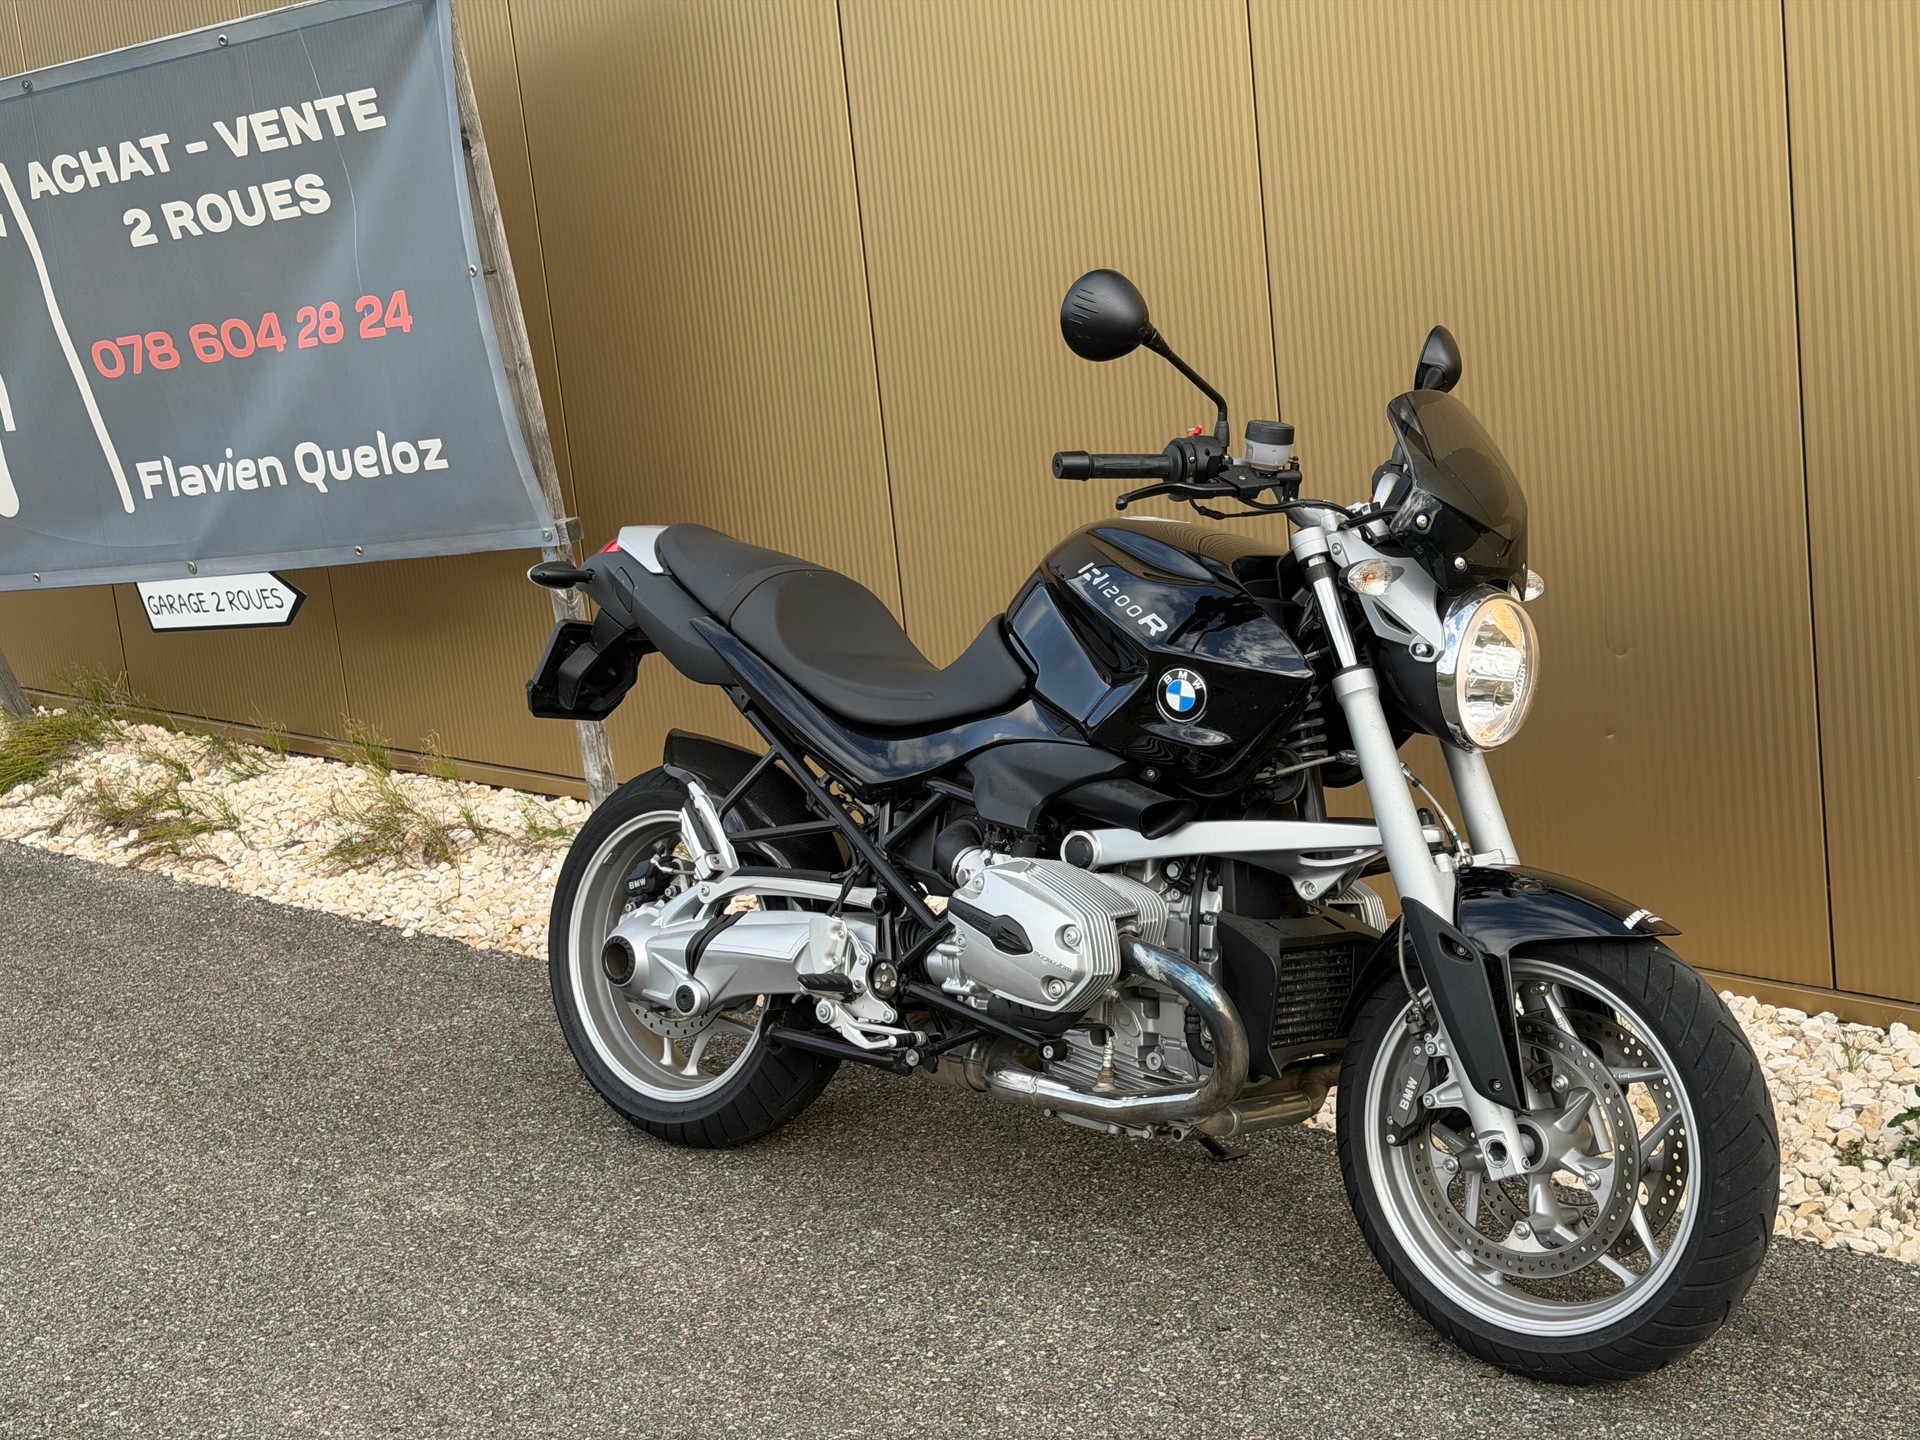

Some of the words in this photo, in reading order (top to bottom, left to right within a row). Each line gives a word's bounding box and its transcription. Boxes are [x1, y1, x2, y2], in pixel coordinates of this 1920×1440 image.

[27, 133, 171, 200] ACHAT
[185, 140, 208, 154] -
[212, 87, 388, 158] VENTE
[123, 208, 159, 248] 2
[160, 173, 332, 240] ROUES
[91, 331, 181, 379] 078
[189, 312, 287, 363] 604
[296, 302, 344, 349] 28
[355, 290, 414, 340] 24
[135, 448, 289, 500] Flavien
[294, 430, 449, 493] Queloz
[147, 592, 210, 616] GARAGE
[210, 591, 226, 612] 2
[225, 587, 285, 612] ROUES
[1163, 670, 1203, 690] BMW
[628, 877, 646, 890] BMW
[1399, 1075, 1418, 1111] BMW
